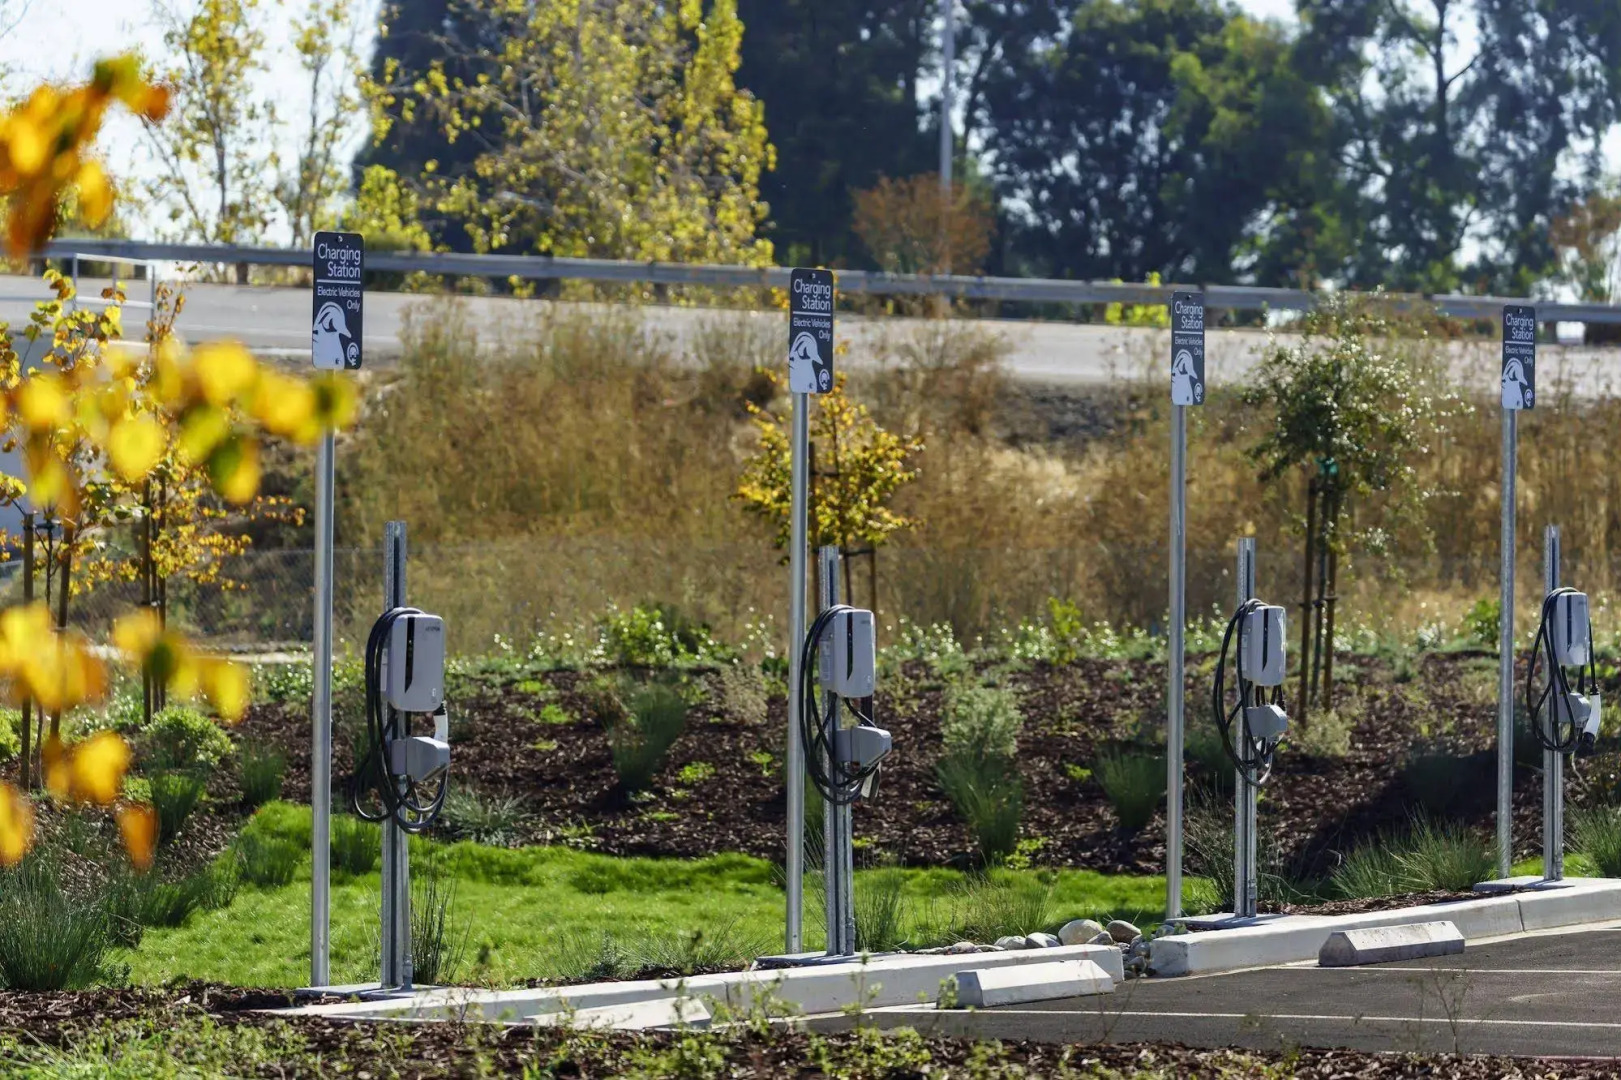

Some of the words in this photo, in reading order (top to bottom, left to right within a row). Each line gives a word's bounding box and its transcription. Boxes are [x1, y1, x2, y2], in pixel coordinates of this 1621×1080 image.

[317, 243, 361, 265] Charging
[327, 261, 361, 278] Station
[317, 286, 338, 296] Electric
[338, 287, 361, 298] Vehicles
[793, 279, 831, 299] Charging
[346, 299, 361, 312] Only
[802, 295, 831, 311] Station
[1174, 301, 1203, 319] Charging
[793, 317, 811, 327] Electric
[811, 318, 831, 328] Vehicles
[1181, 315, 1203, 329] Station
[1505, 313, 1534, 331] Charging
[818, 330, 831, 341] Only
[1511, 327, 1534, 340] Station
